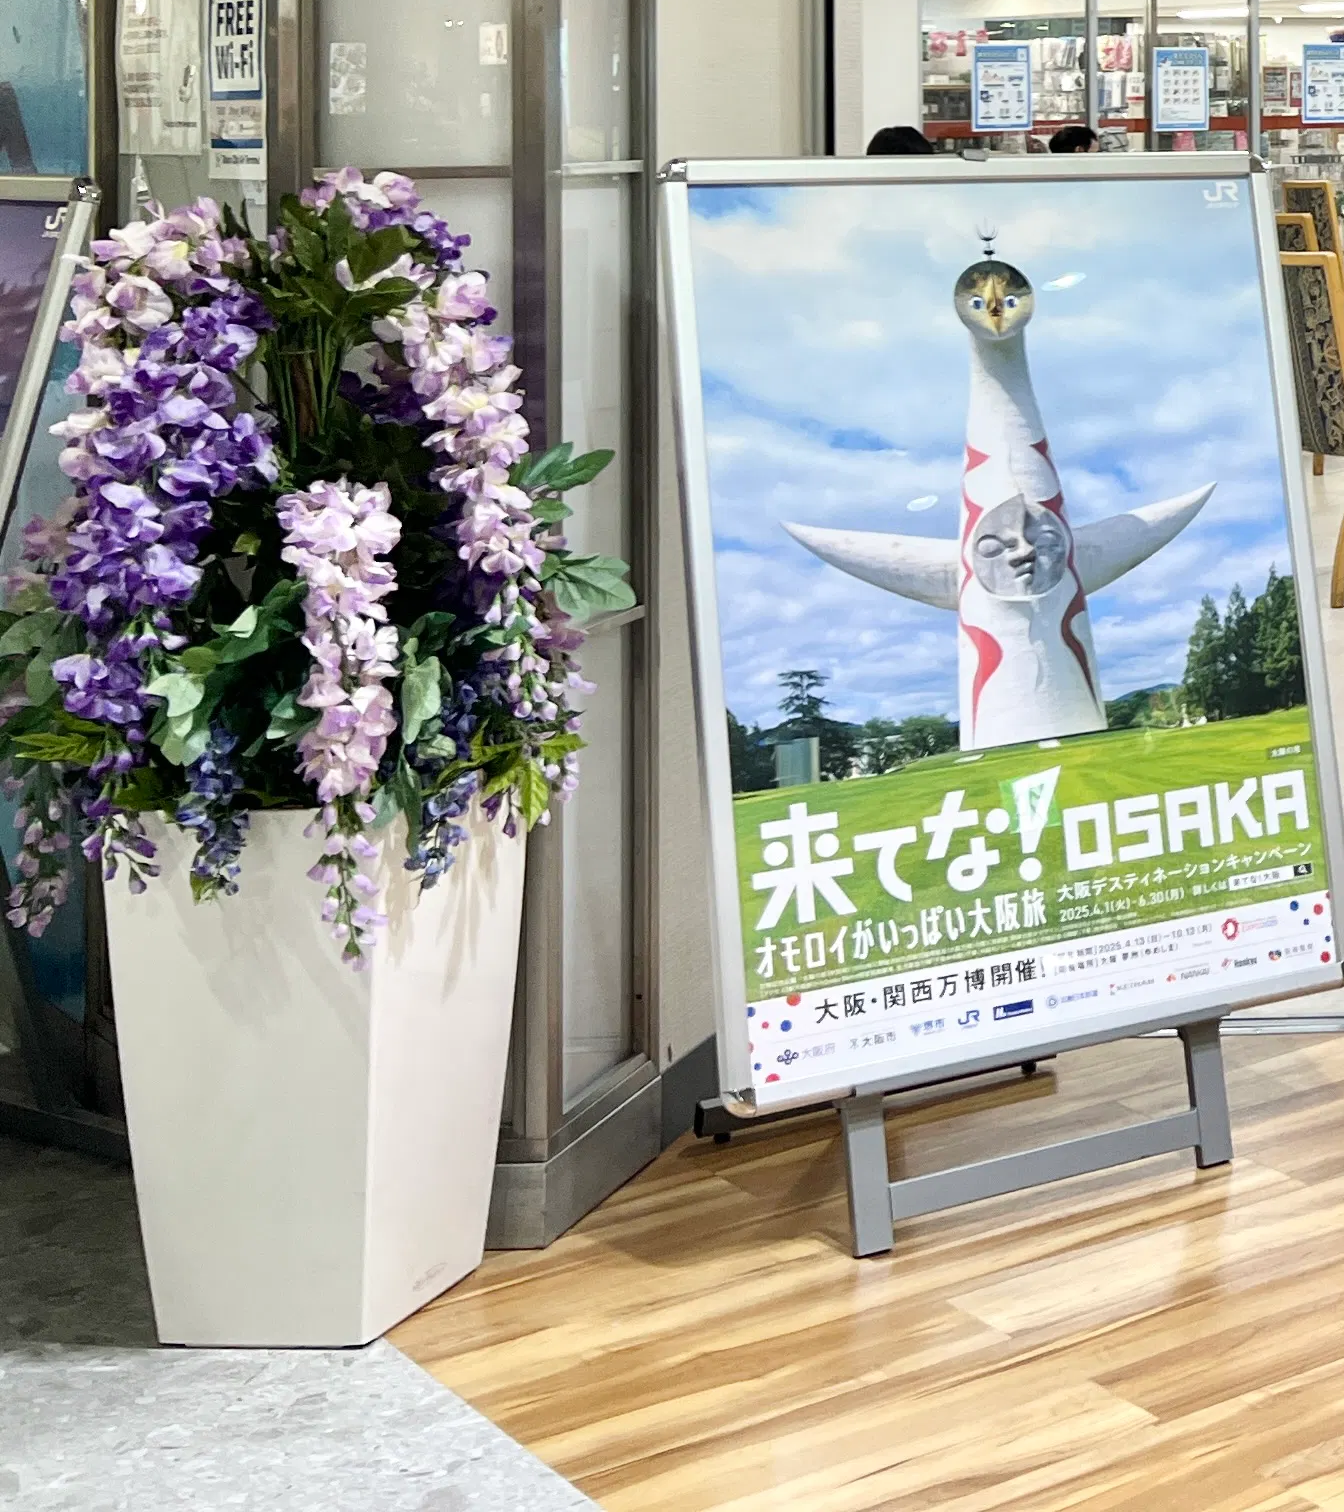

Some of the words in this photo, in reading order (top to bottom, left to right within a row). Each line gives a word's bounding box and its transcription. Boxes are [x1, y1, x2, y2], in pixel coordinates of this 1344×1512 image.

[216, 0, 255, 37] FREE
[215, 39, 255, 80] Wi-Fi
[1203, 180, 1240, 202] JR
[1063, 769, 1311, 874] OSAKA
[1056, 842, 1313, 903] 大阪デスティネーションキャンペーン
[754, 887, 1048, 979] オモロイがいっぱい大阪旅
[957, 1009, 980, 1027] JR
